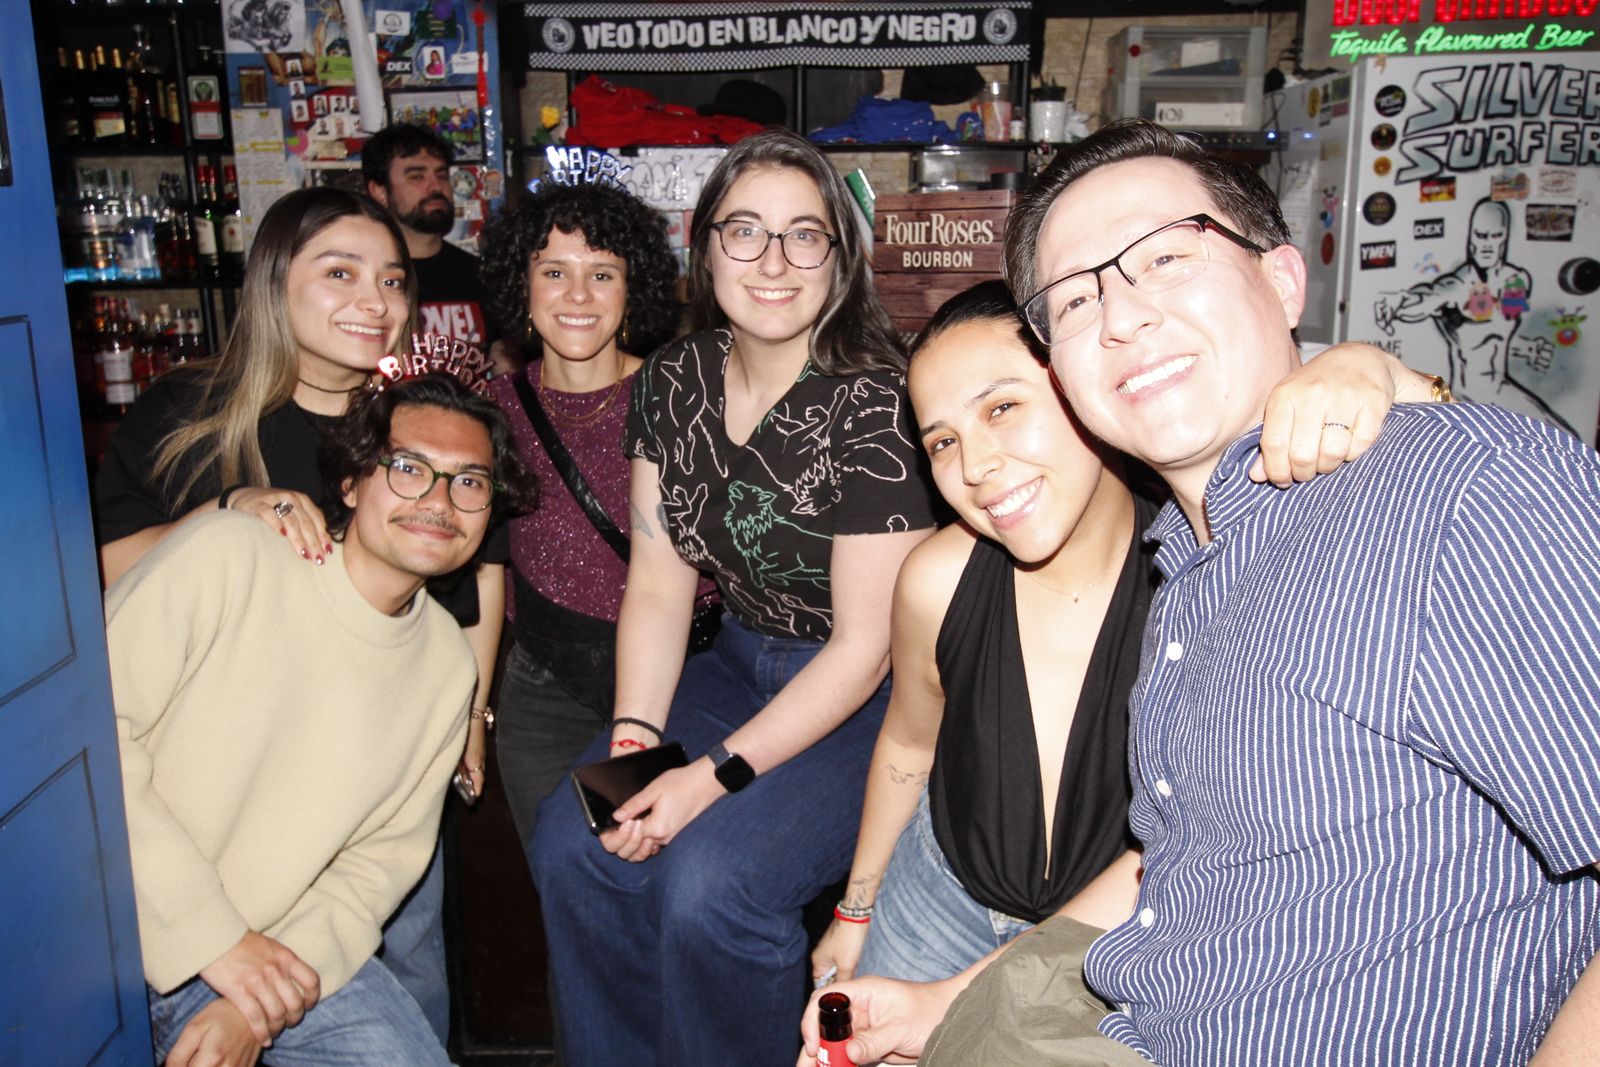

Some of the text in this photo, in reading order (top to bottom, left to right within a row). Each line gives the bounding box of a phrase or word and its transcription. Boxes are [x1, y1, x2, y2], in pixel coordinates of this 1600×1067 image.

[582, 22, 634, 50] VEO
[636, 20, 705, 48] TODO
[708, 18, 744, 46] EN
[748, 15, 857, 45] BLANCO
[888, 13, 976, 43] NEGRO
[1330, 29, 1408, 62] Tequila
[1535, 24, 1595, 50] Beer
[386, 61, 412, 71] DEX
[1403, 62, 1600, 136] SILVER
[1394, 121, 1600, 185] SURFER
[886, 213, 994, 247] Four Roses
[1414, 224, 1442, 236] DEX
[903, 251, 973, 267] BOURBON
[412, 332, 496, 375] HAPPY
